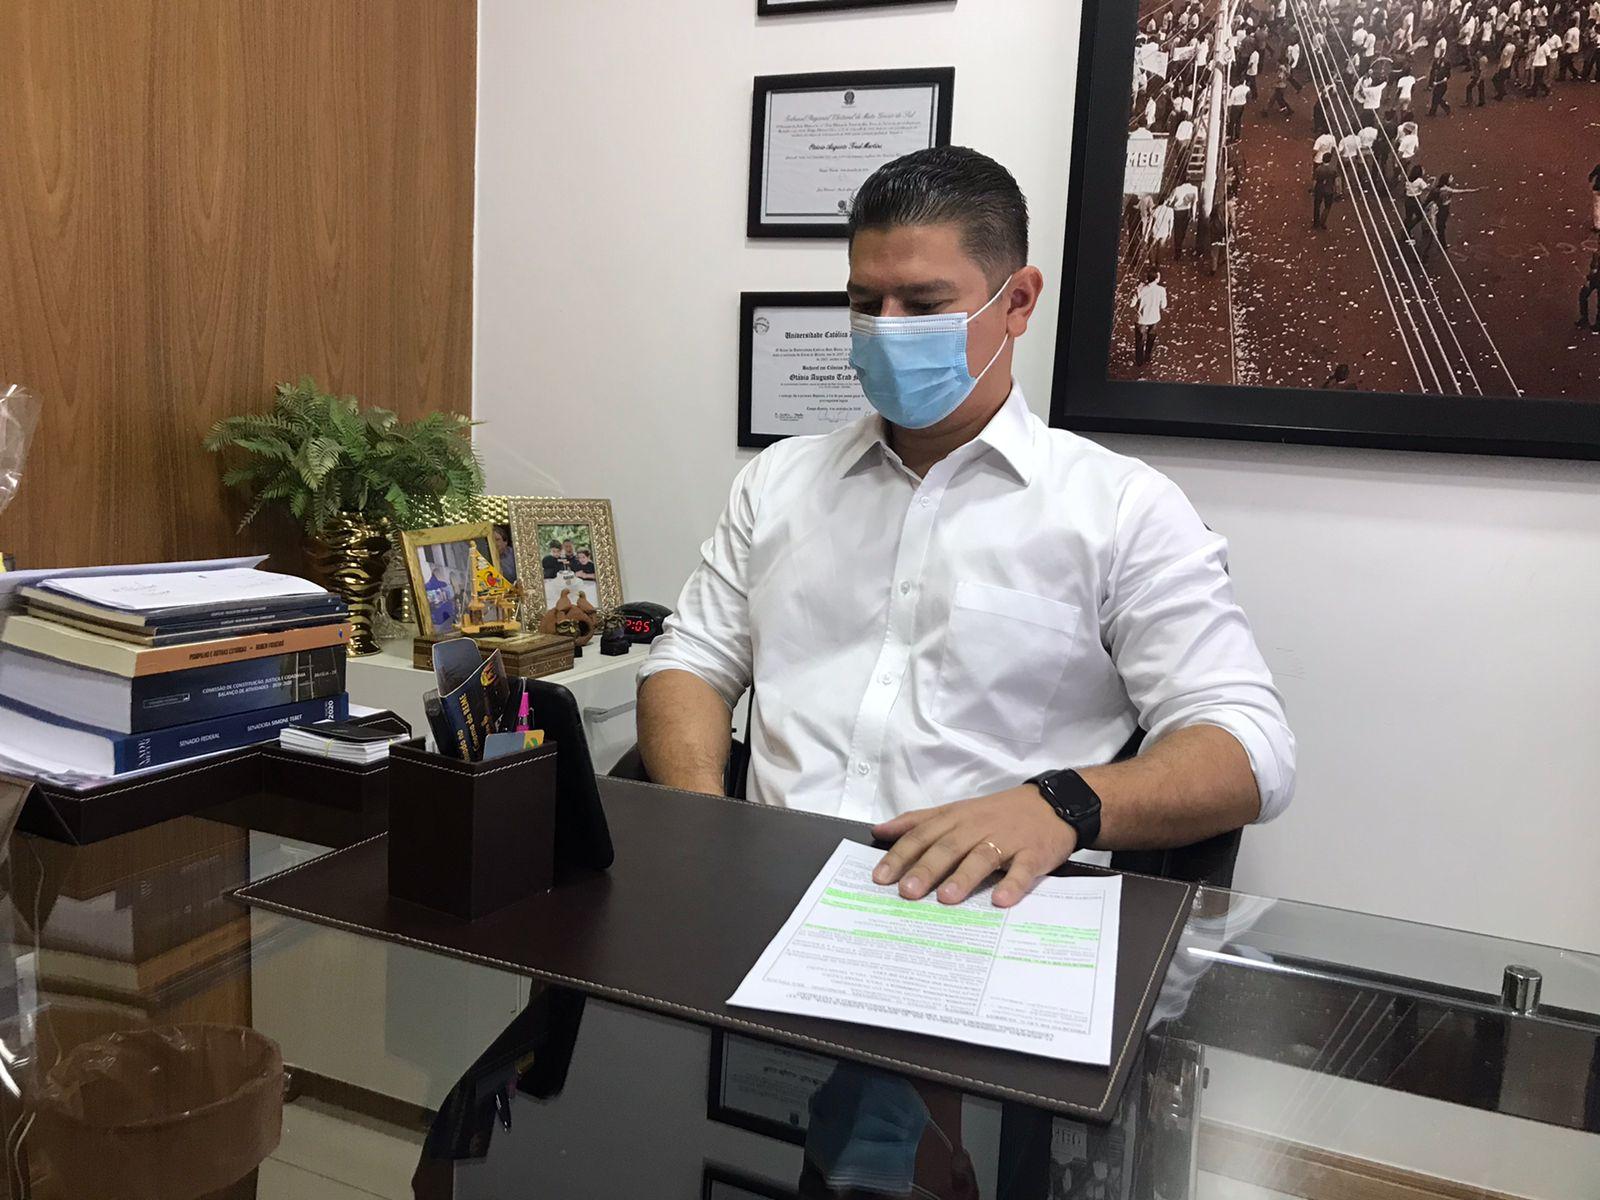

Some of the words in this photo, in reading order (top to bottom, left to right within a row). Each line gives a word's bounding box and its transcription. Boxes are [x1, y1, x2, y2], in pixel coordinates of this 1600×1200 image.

[785, 331, 823, 339] Universidade
[218, 688, 239, 697] BALANÇO
[179, 736, 200, 748] SENADO
[200, 732, 220, 744] FEDERAL
[247, 721, 271, 732] SENADORA
[271, 717, 289, 728] SIMONE
